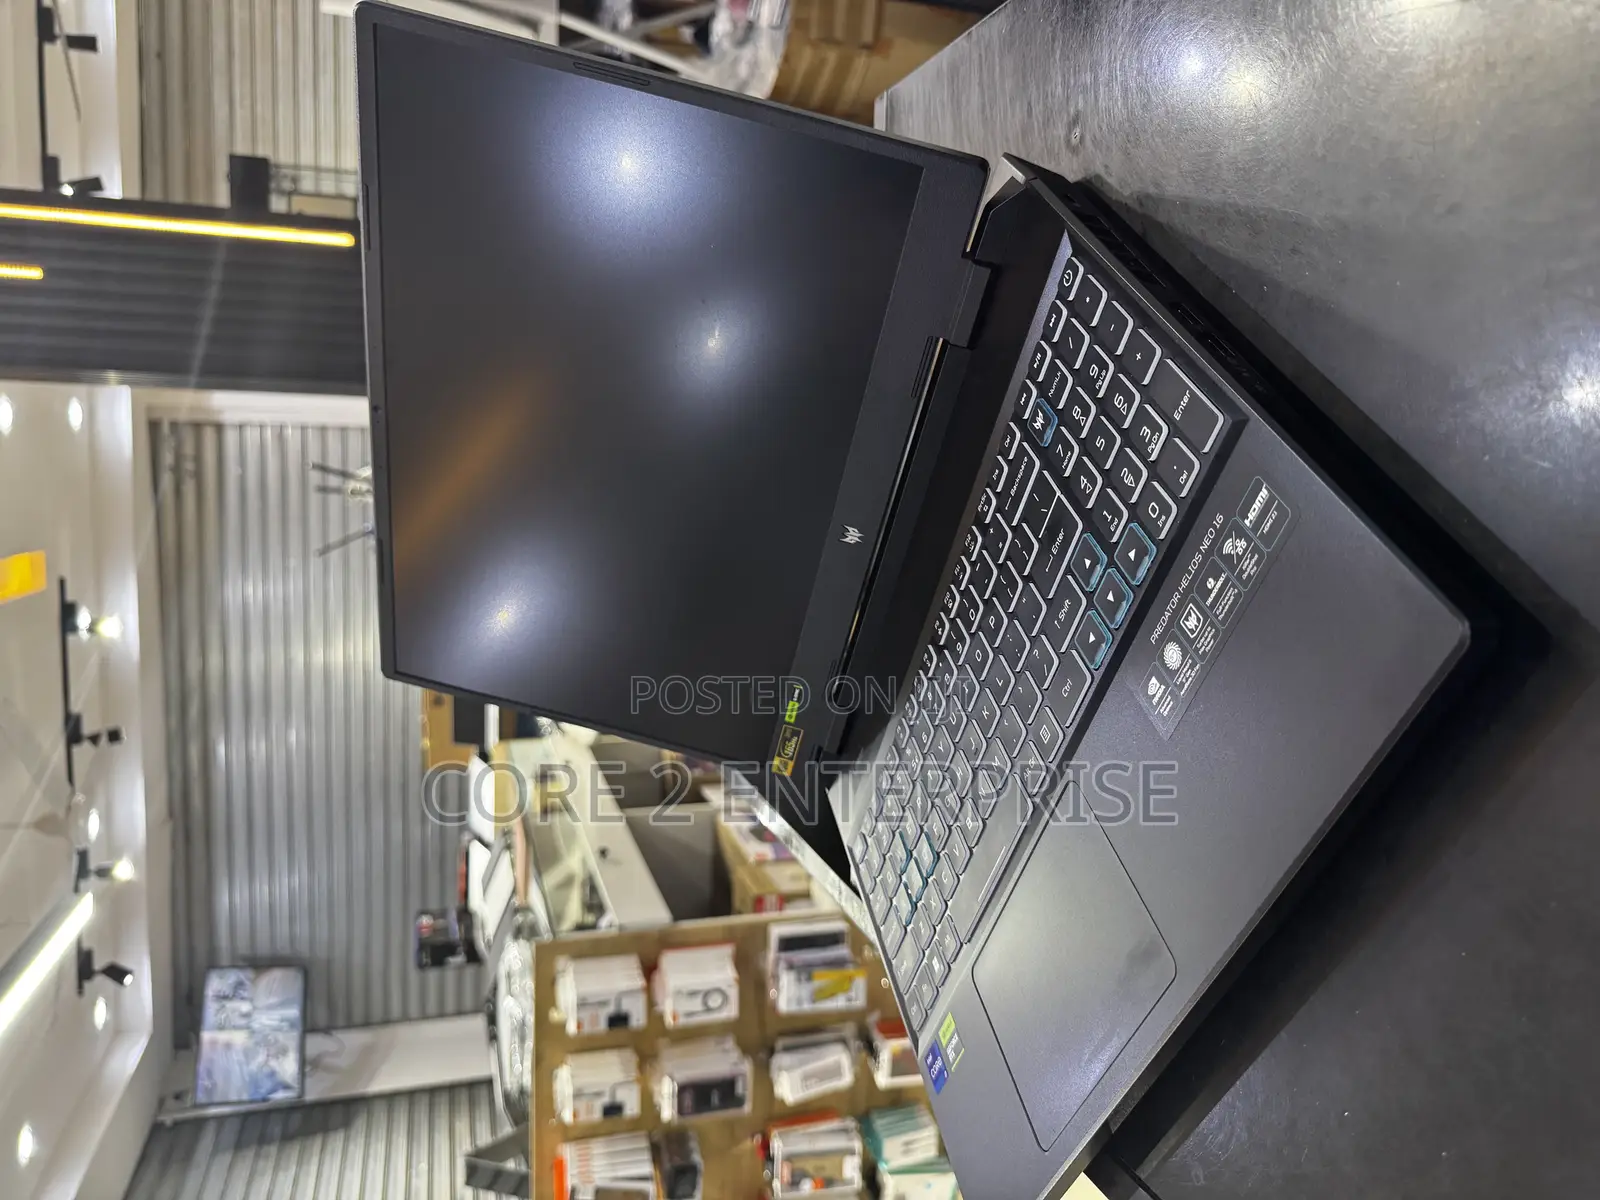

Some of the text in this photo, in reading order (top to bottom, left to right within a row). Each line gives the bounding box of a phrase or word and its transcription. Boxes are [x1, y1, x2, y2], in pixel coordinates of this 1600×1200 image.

[1089, 364, 1098, 378] 9
[1048, 371, 1061, 397] NumLk
[1113, 392, 1123, 409] 6
[1173, 390, 1190, 420] Enter
[1072, 405, 1081, 419] 8
[1139, 425, 1150, 442] 3
[1055, 443, 1063, 456] 7
[1095, 435, 1105, 450] 5
[1061, 450, 1071, 469] Home
[1010, 456, 1027, 496] Backspace
[1080, 475, 1087, 489] 4
[1120, 467, 1131, 483] 2
[1179, 470, 1187, 484] Del
[977, 493, 986, 511] PrtSc
[1102, 510, 1111, 521] 1
[1148, 501, 1158, 518] 0
[1109, 517, 1118, 531] End
[1157, 514, 1165, 527] Ins
[1262, 517, 1272, 533] HDMI
[1051, 528, 1064, 554] Enter
[1150, 512, 1223, 644] PREDATOR HELIOS NEO 16
[1216, 587, 1233, 614] Full-Function
[1058, 599, 1070, 621] Shift
[988, 615, 994, 628] P
[956, 642, 962, 653] 9
[1205, 638, 1213, 652] Power
[975, 649, 981, 661] O
[944, 672, 950, 684] 8
[995, 677, 1003, 686] L
[1061, 678, 1072, 697] Ctrl
[949, 711, 956, 724] U
[981, 705, 989, 719] K
[921, 731, 927, 742] 6
[969, 736, 975, 749] J
[937, 740, 943, 752] Y
[991, 755, 1000, 770] M
[1023, 754, 1037, 780] Alt Gr
[927, 769, 932, 779] T
[955, 766, 962, 780] H
[978, 784, 985, 802] N
[916, 793, 921, 808] R
[944, 795, 951, 807] G
[905, 821, 911, 834] E
[932, 822, 937, 835] F
[965, 814, 972, 829] B
[952, 843, 959, 856] V
[941, 870, 947, 884] C
[929, 895, 936, 909] X
[918, 920, 924, 934] Z
